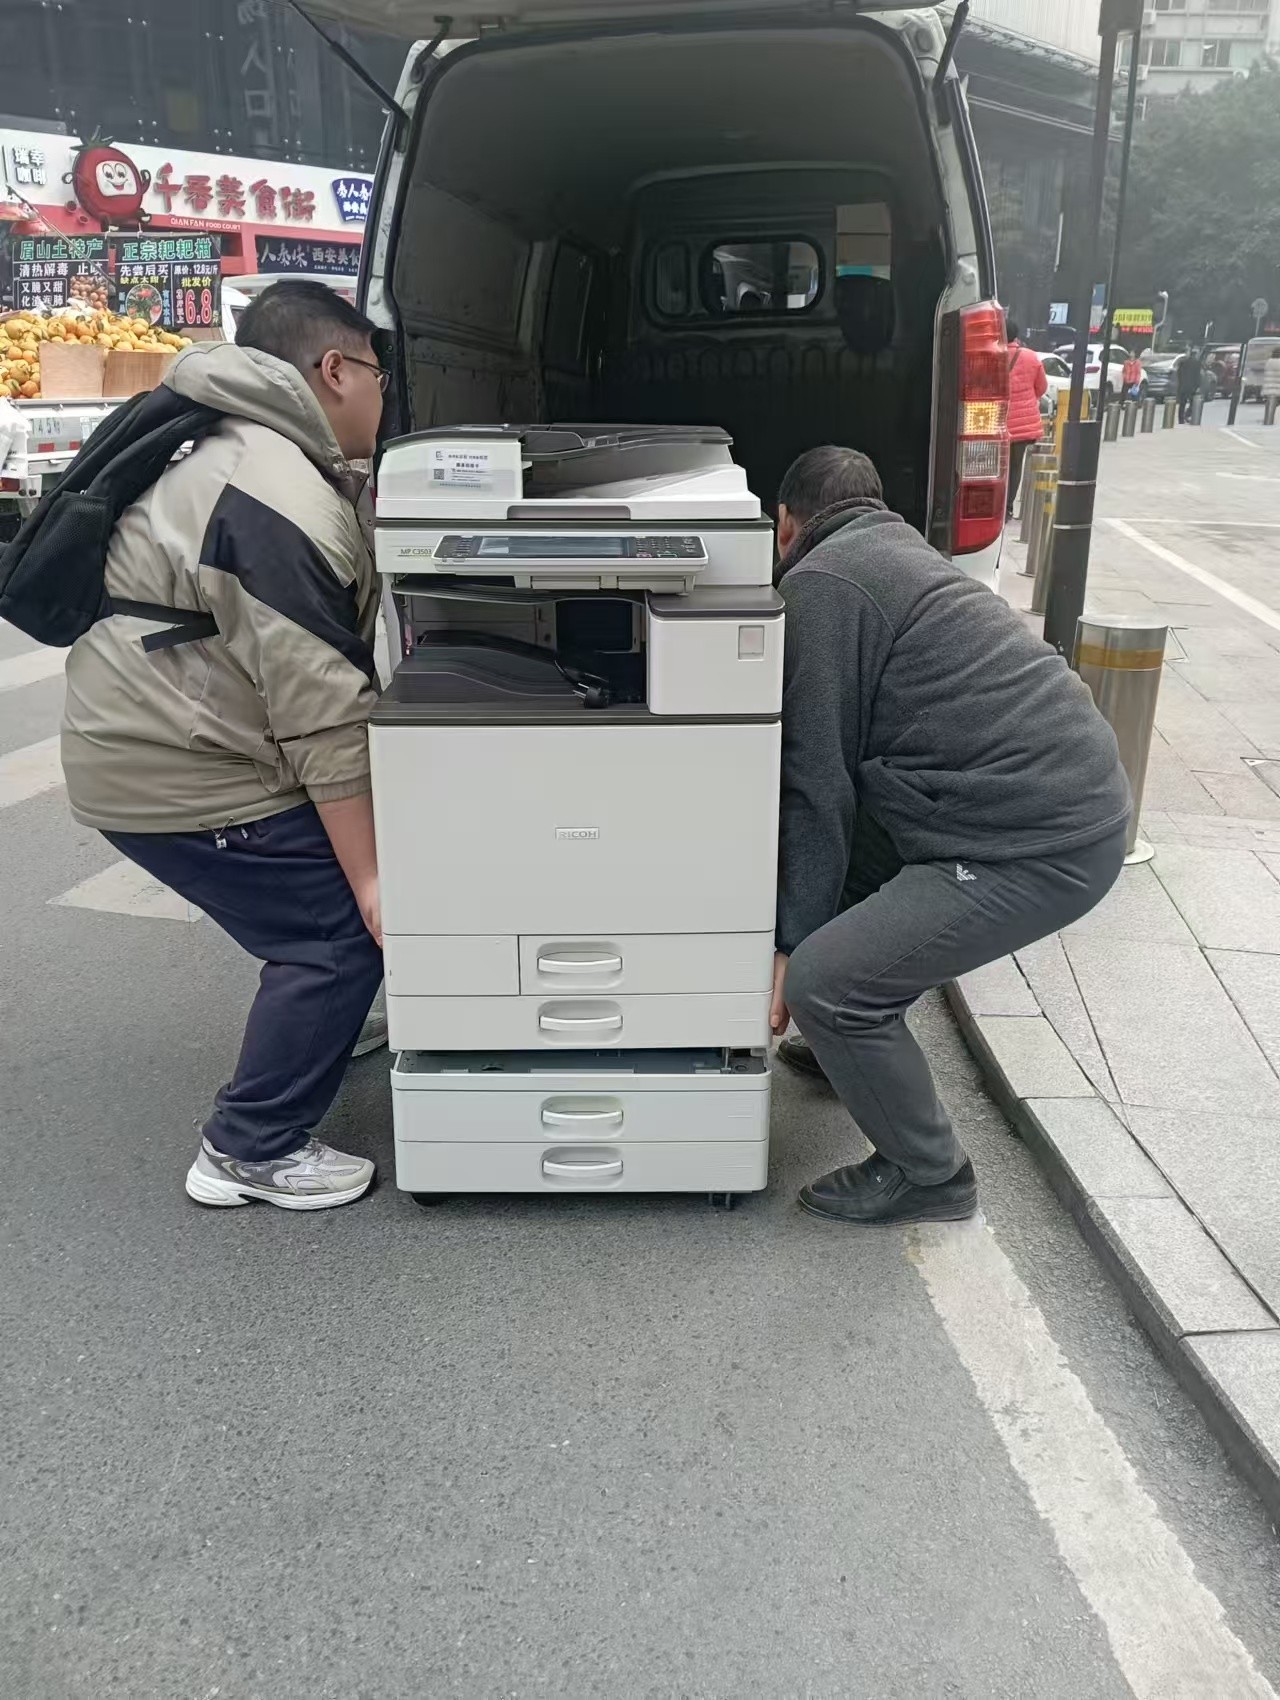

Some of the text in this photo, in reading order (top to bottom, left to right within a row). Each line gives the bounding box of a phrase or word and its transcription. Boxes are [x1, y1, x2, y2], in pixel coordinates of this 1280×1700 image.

[153, 162, 316, 221] 千番美食街
[206, 221, 221, 229] FOOD
[222, 222, 241, 231] COURT
[20, 238, 103, 260] 眉山土特产
[19, 262, 69, 277] 清热解毒
[120, 264, 168, 277] 先尝后买
[181, 276, 212, 287] 批发价
[185, 288, 212, 325] 6.8
[558, 830, 598, 839] RICOH
